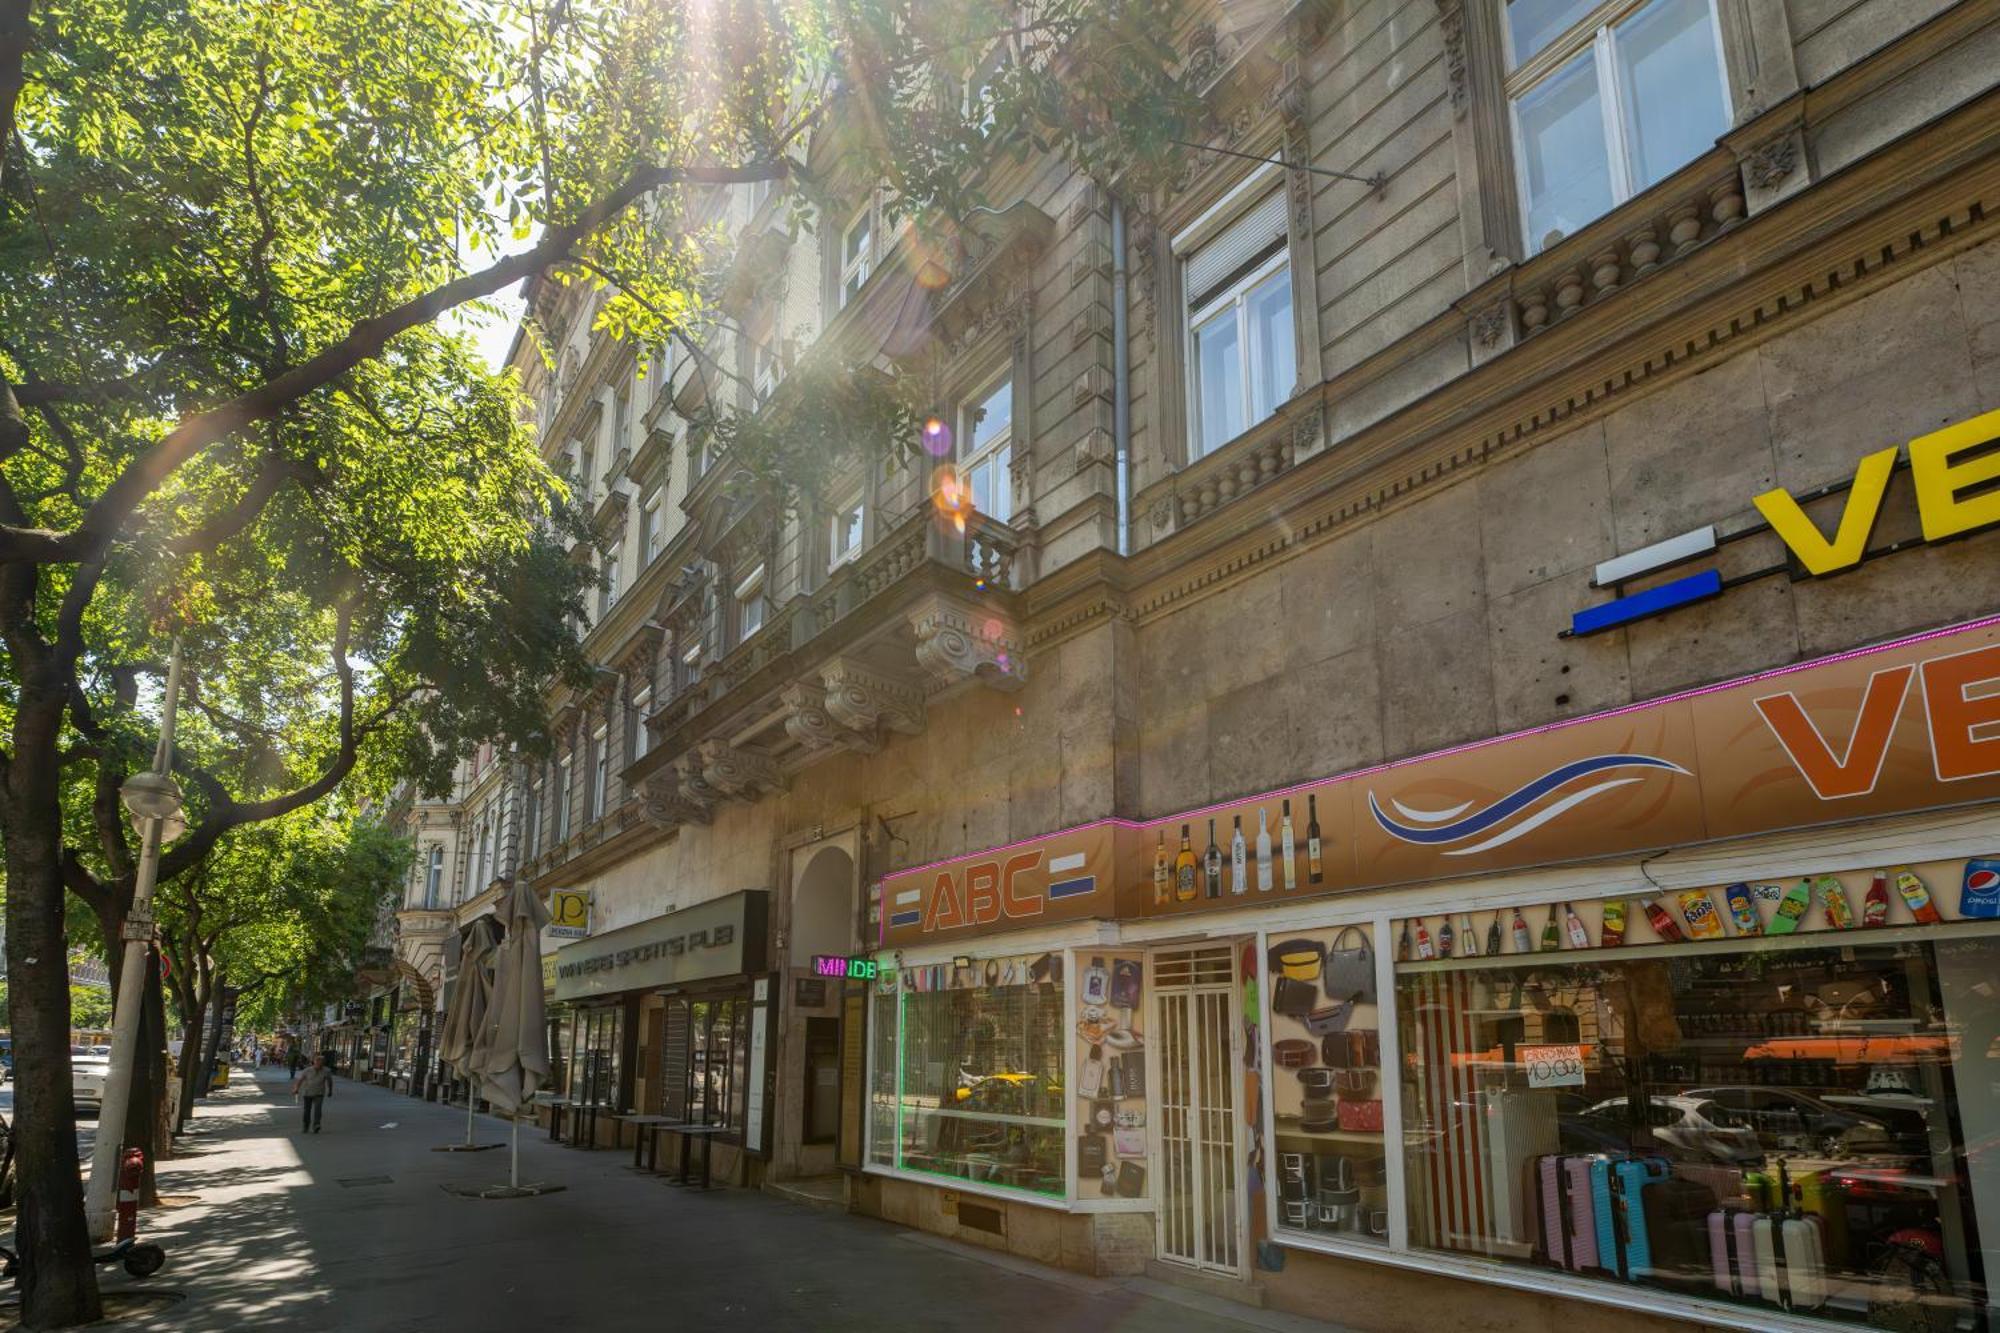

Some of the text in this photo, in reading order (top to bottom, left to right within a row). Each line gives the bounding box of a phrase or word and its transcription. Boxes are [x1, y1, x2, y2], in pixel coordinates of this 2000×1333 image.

[1752, 408, 2000, 576] VE
[1753, 643, 2000, 800] VE
[689, 925, 734, 952] PUB
[923, 849, 1045, 933] ABC
